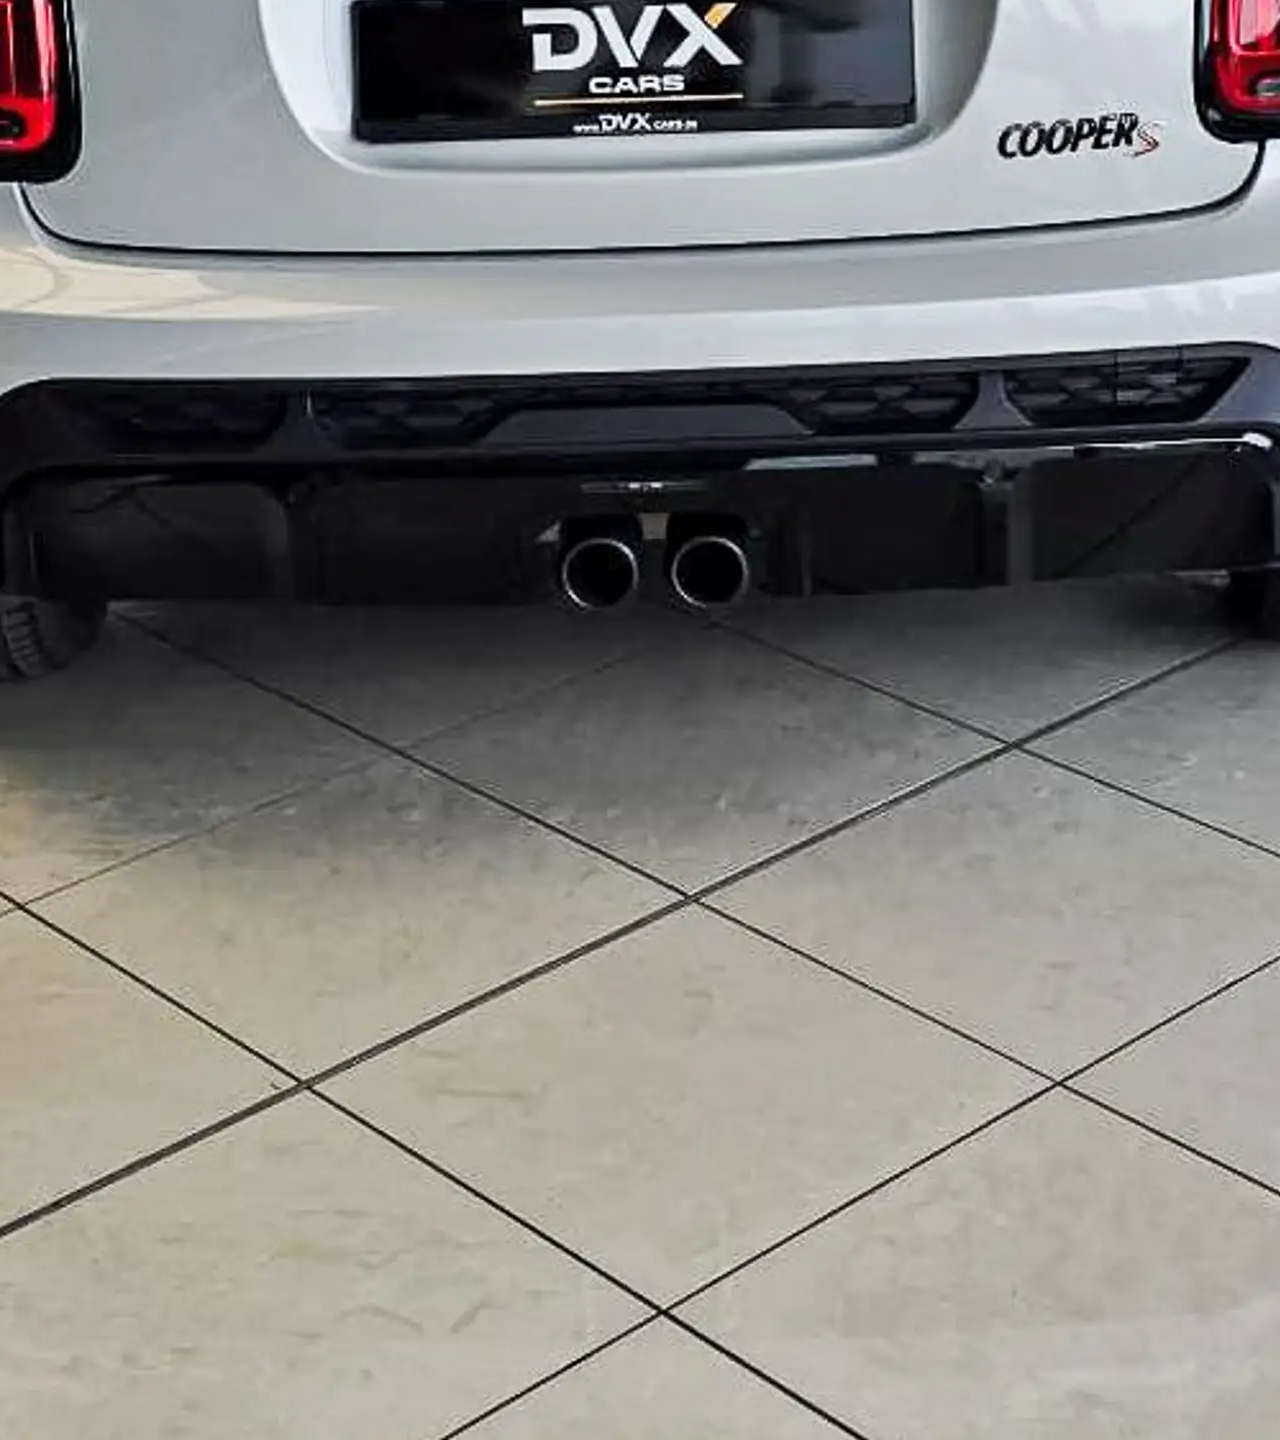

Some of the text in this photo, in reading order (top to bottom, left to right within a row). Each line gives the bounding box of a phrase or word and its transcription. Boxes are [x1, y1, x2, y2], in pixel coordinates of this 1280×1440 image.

[522, 2, 743, 72] DVX
[588, 73, 686, 94] CARS
[997, 112, 1139, 159] COOPER
